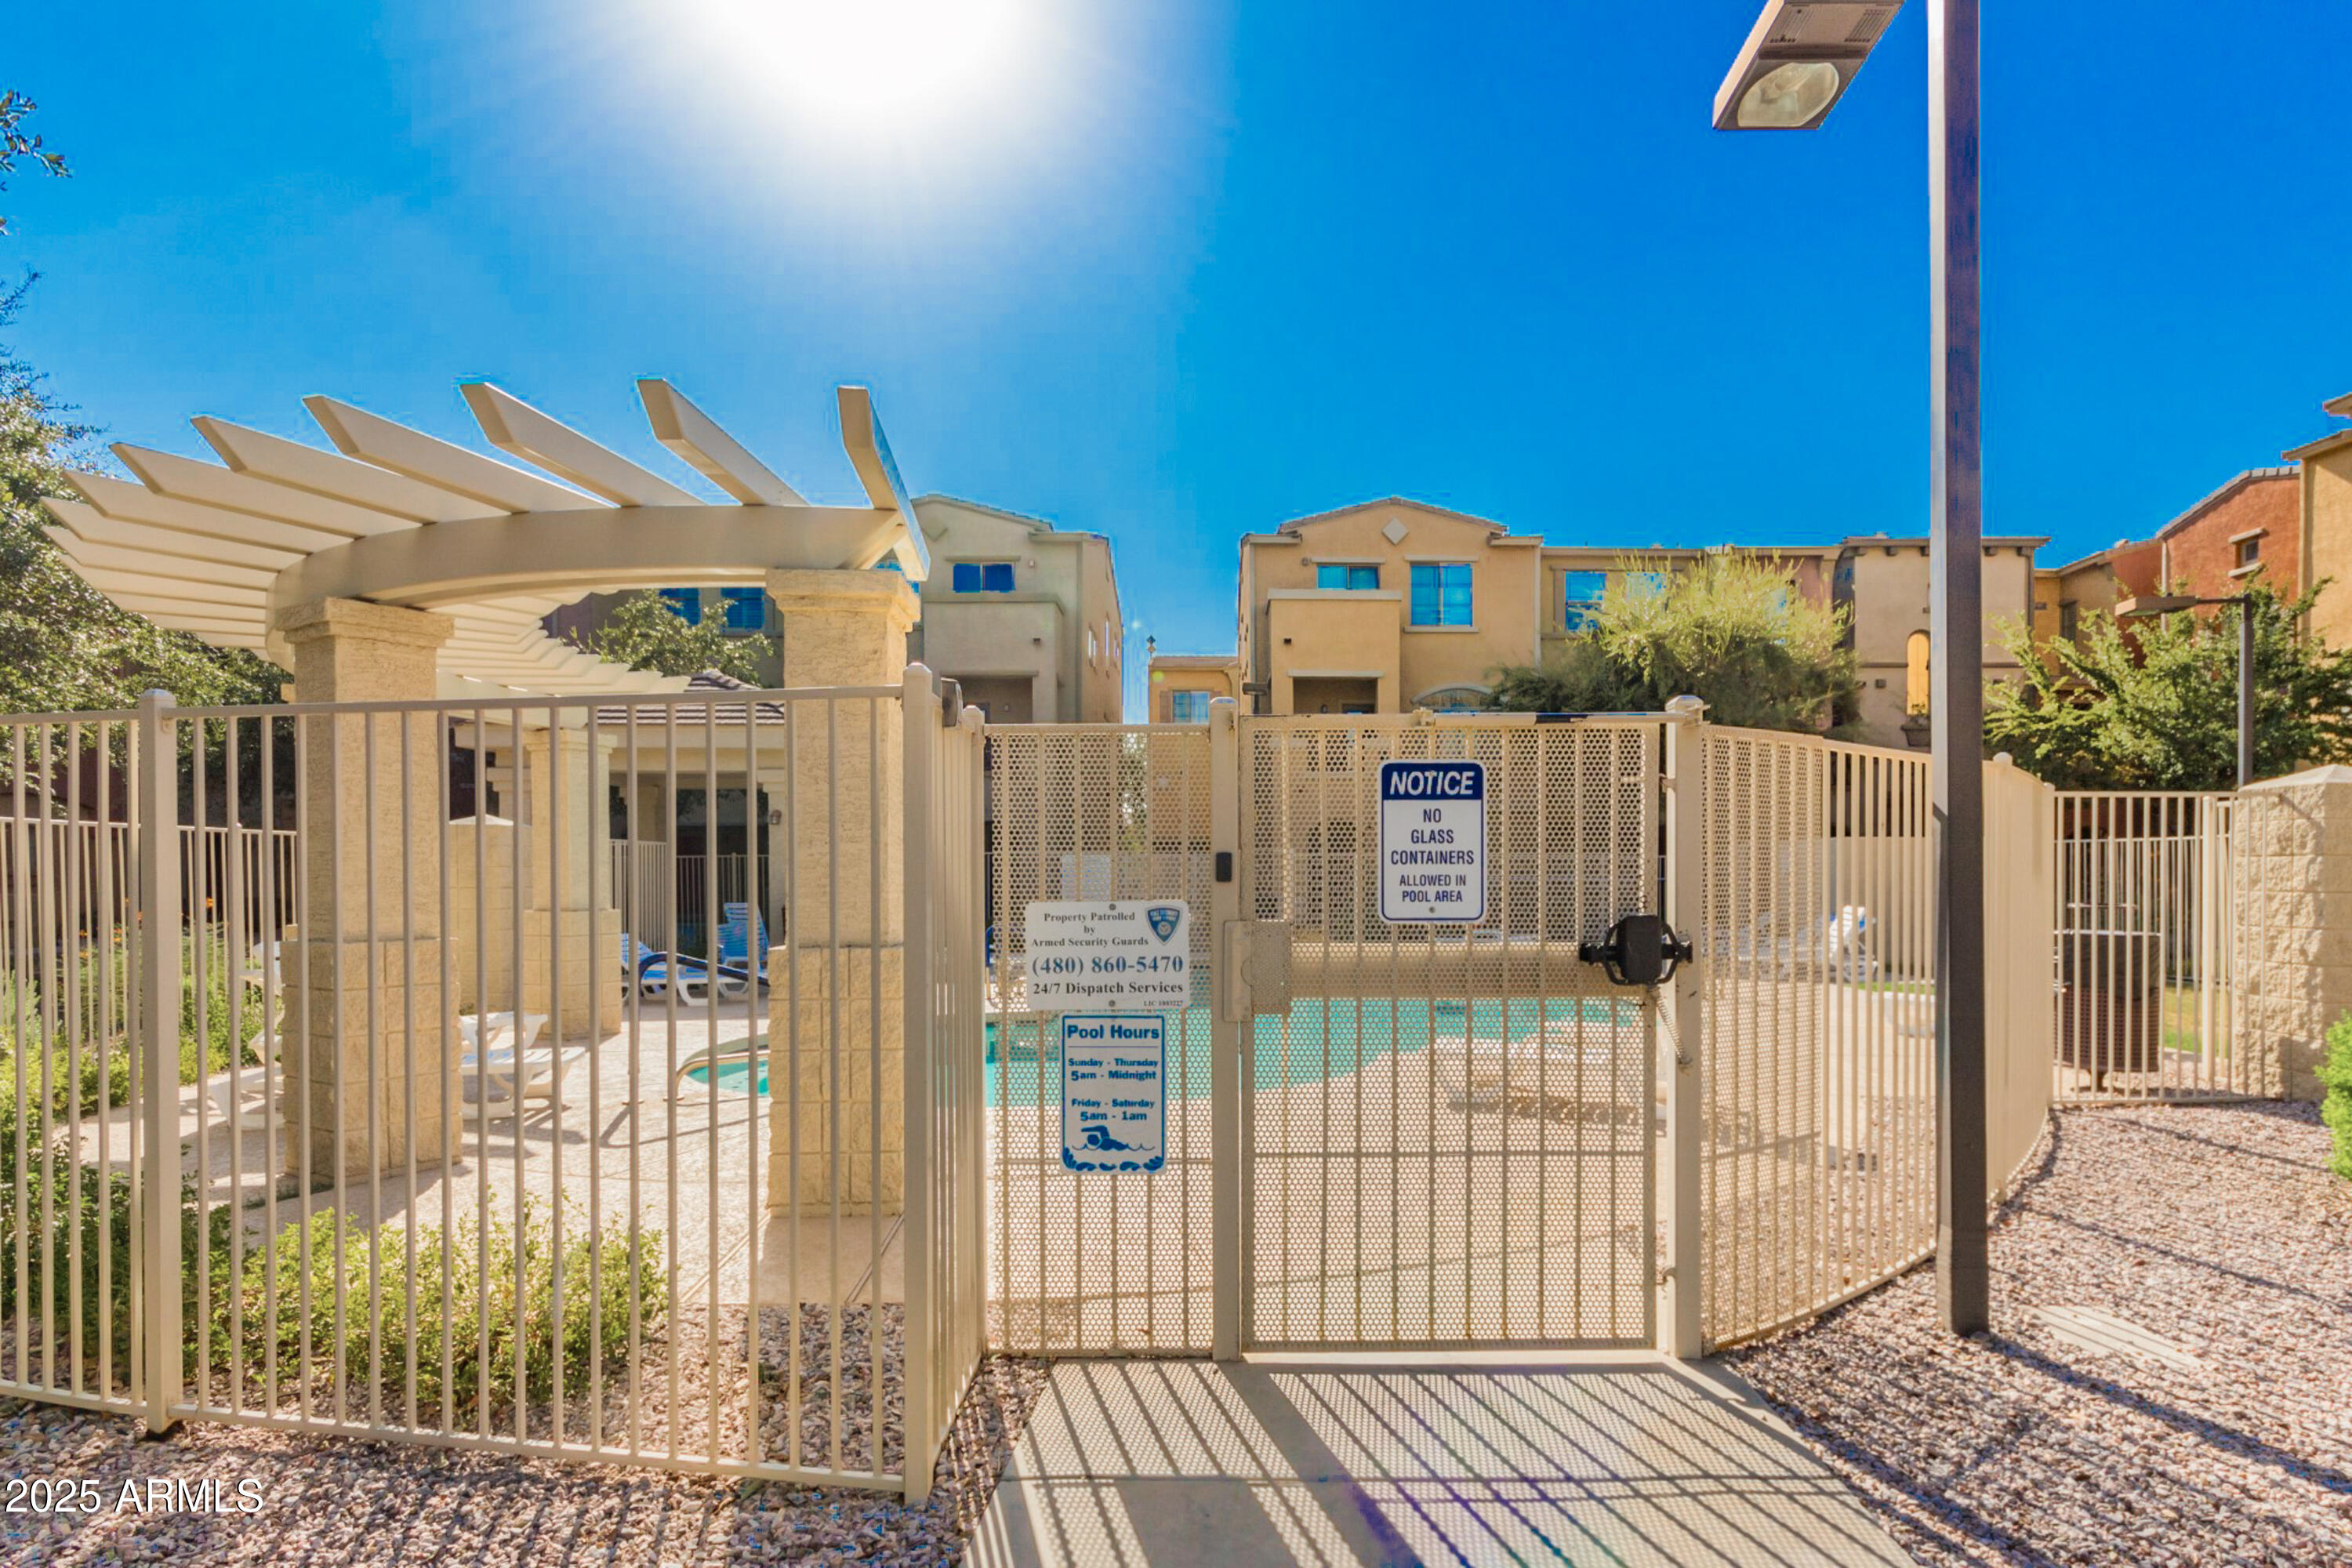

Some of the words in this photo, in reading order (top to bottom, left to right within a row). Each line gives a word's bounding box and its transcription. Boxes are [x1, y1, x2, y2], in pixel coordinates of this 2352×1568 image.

[1390, 771, 1475, 796] NOTICE
[1423, 808, 1442, 823] NO
[1411, 829, 1454, 844] GLASS
[1391, 850, 1475, 865] CONTAINERS
[1399, 874, 1451, 886] ALLOWED
[1455, 874, 1467, 886] IN
[1402, 890, 1431, 902] POOL
[1434, 890, 1463, 902] AREA
[1044, 913, 1087, 924] Property
[1091, 912, 1135, 921] Patrolled
[1083, 925, 1095, 935] by
[1033, 938, 1065, 947] Armed
[1068, 938, 1109, 948] Security
[1112, 937, 1149, 946] Guards
[1032, 956, 1083, 977] (480)
[1091, 955, 1183, 973] 860-5470
[1033, 982, 1061, 994] 24/7
[1066, 982, 1123, 996] Dispatch
[1129, 981, 1183, 993] Services
[1067, 1024, 1104, 1039] Pool
[1110, 1024, 1160, 1039] Hours
[1068, 1058, 1104, 1068] Sunday
[1114, 1058, 1159, 1068] Thursday
[1071, 1070, 1097, 1081] 5am
[1108, 1070, 1156, 1081] Midnight
[1071, 1098, 1102, 1108] Friday
[1112, 1098, 1155, 1109] Saturday
[1080, 1111, 1108, 1121] 5am
[1122, 1111, 1147, 1120] 1am
